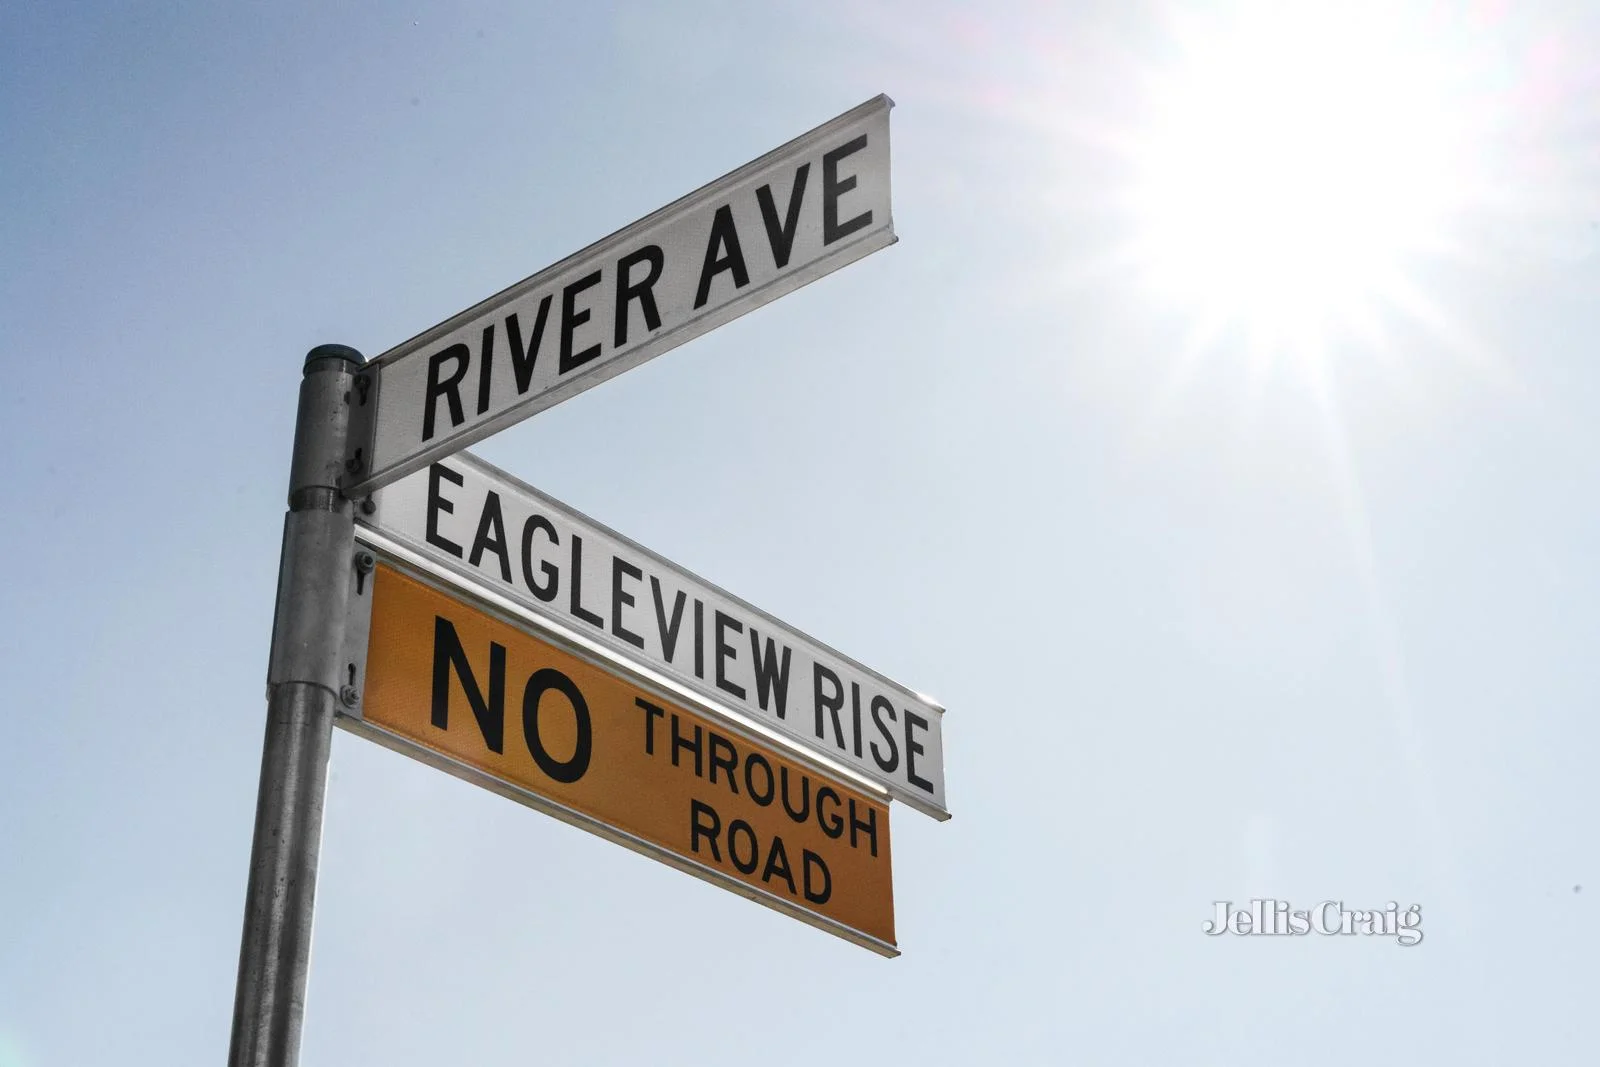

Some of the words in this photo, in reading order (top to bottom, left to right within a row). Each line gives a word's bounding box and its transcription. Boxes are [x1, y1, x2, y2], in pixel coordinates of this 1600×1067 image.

[422, 244, 665, 443] RIVER
[693, 133, 874, 311] AVE
[425, 462, 792, 720] EAGLEVIEW
[812, 661, 935, 795] RISE
[430, 615, 593, 784] NO
[634, 697, 879, 858] THROUGH
[689, 799, 833, 906] ROAD
